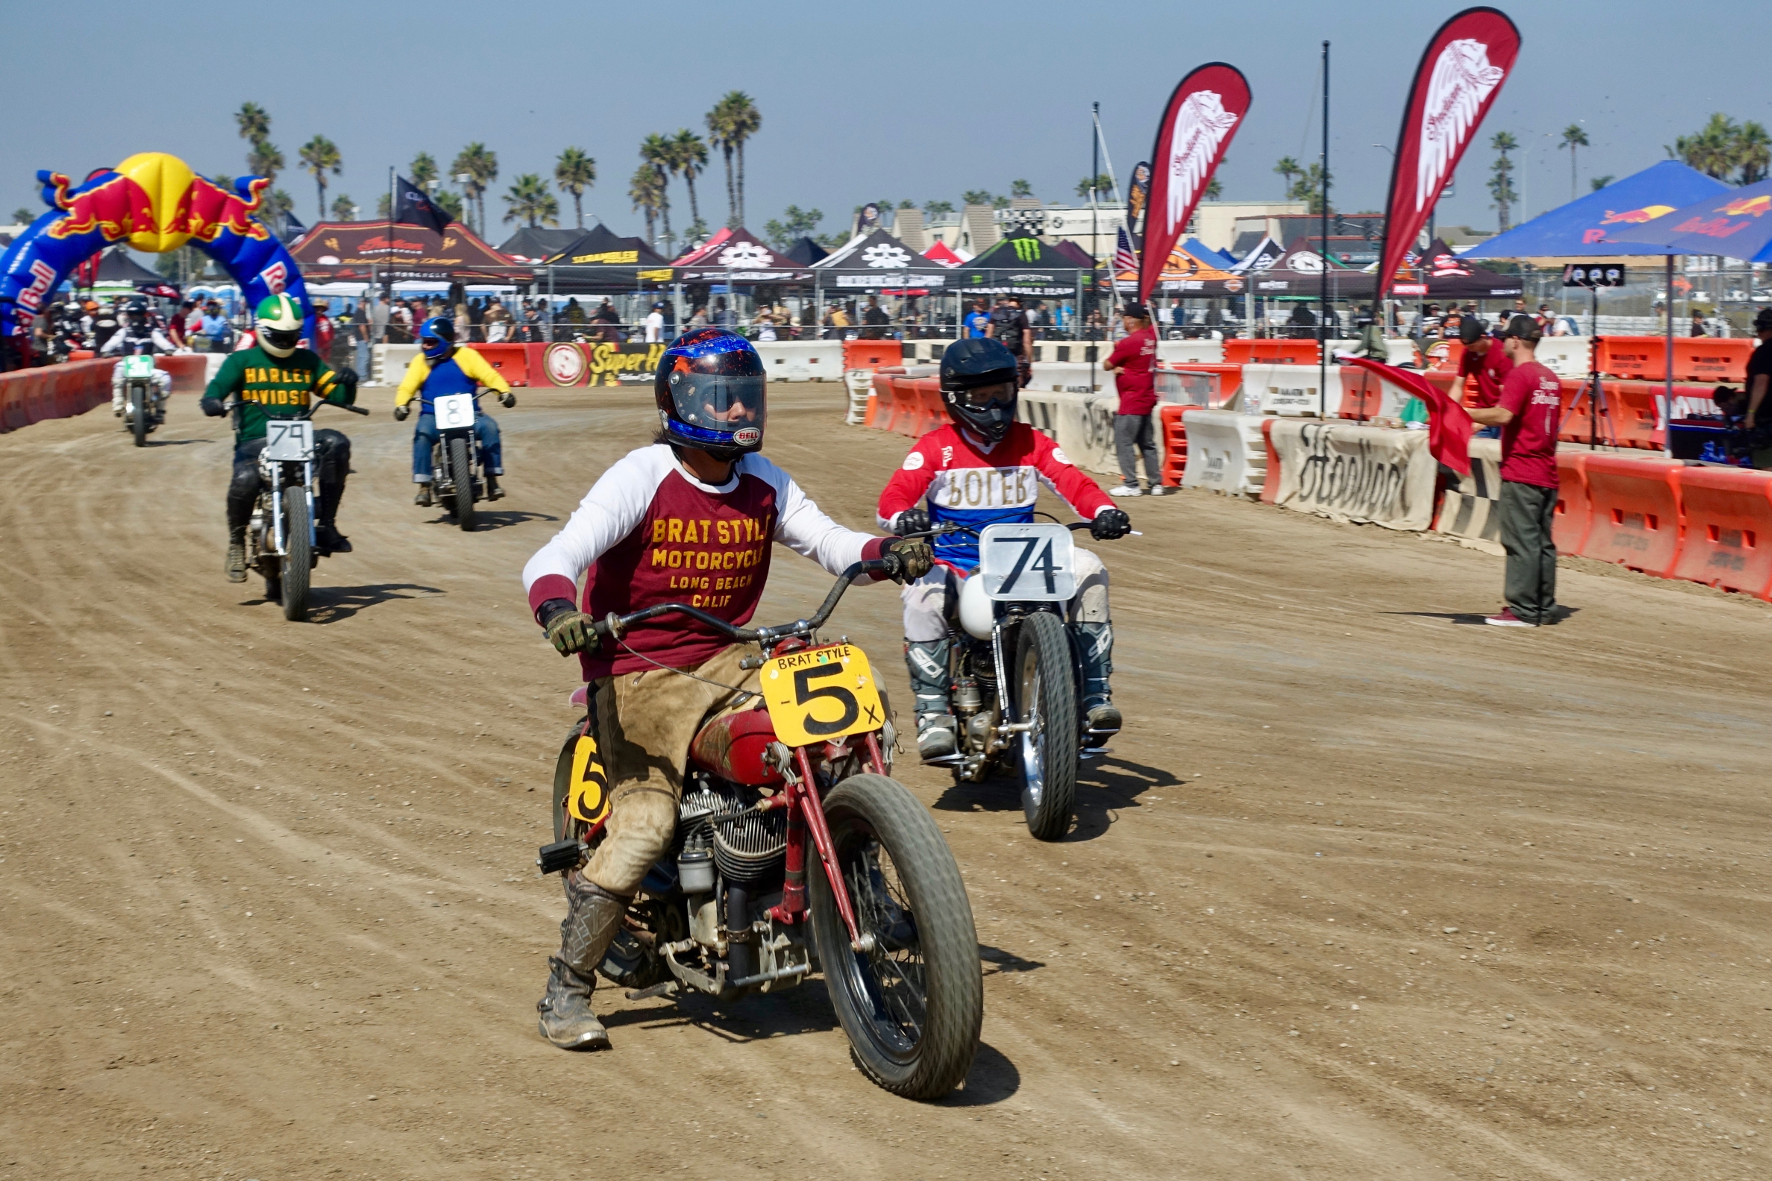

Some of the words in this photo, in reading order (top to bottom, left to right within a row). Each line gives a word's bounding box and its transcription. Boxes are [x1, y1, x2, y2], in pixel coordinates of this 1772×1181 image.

[15, 258, 57, 311] Bull
[244, 367, 312, 384] HARLEY
[446, 399, 462, 425] 8
[270, 424, 305, 451] 79
[738, 431, 758, 440] BELL
[652, 518, 712, 544] BRAT
[992, 536, 1063, 594] 74
[669, 576, 710, 590] LONG
[715, 574, 752, 591] BEACH
[692, 594, 732, 608] CALIF
[777, 653, 812, 670] BRAT
[815, 646, 852, 663] STYLE
[793, 661, 859, 736] 5
[577, 750, 609, 820] 5
